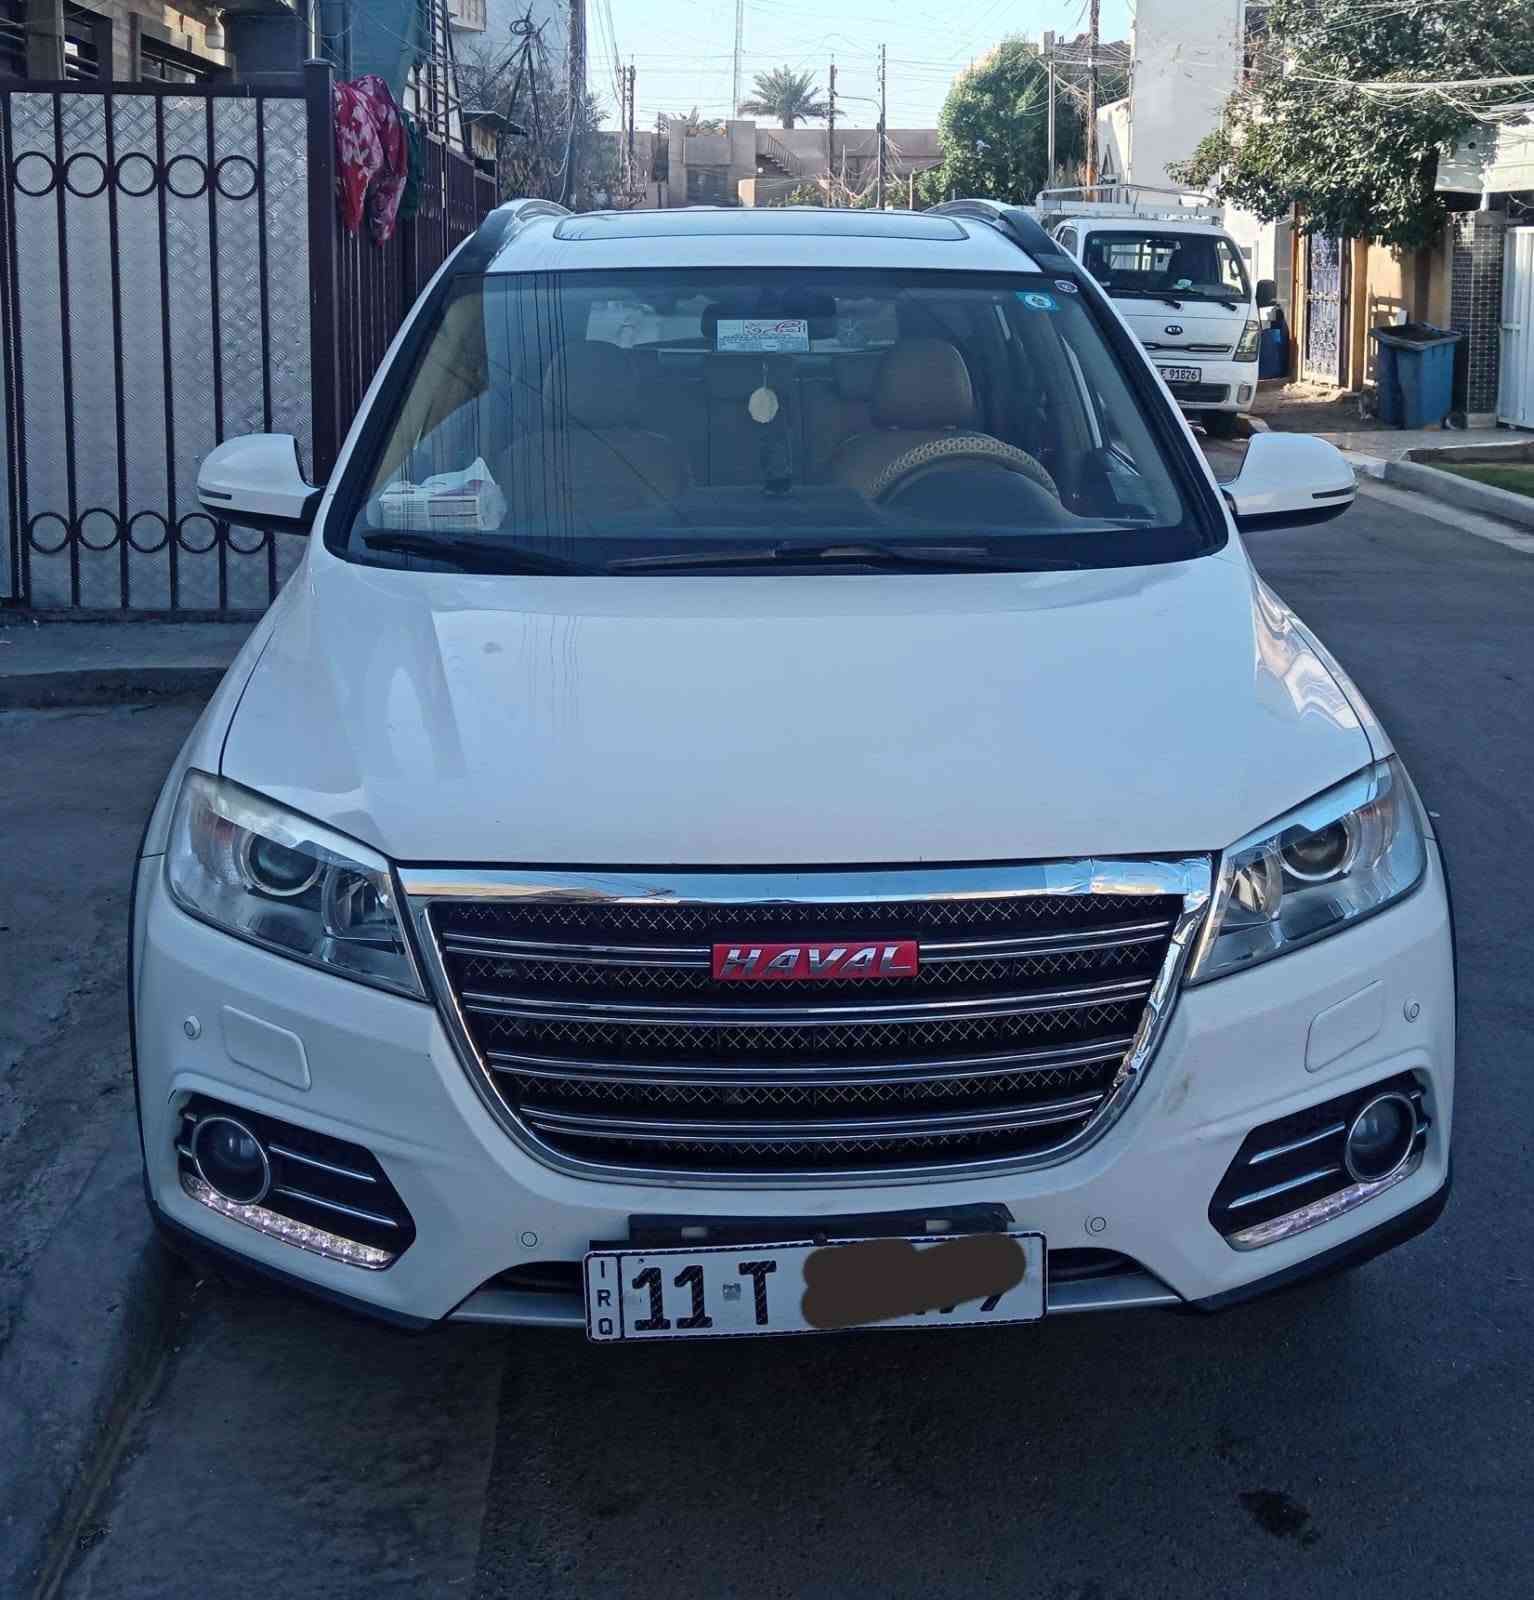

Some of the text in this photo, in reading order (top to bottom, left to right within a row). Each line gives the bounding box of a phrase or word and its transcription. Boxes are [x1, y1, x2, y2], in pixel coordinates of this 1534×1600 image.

[1166, 326, 1182, 334] KIA
[720, 946, 912, 977] HAVAL
[597, 1261, 613, 1335] IRQ
[632, 1264, 713, 1331] 11
[738, 1260, 777, 1325] T
